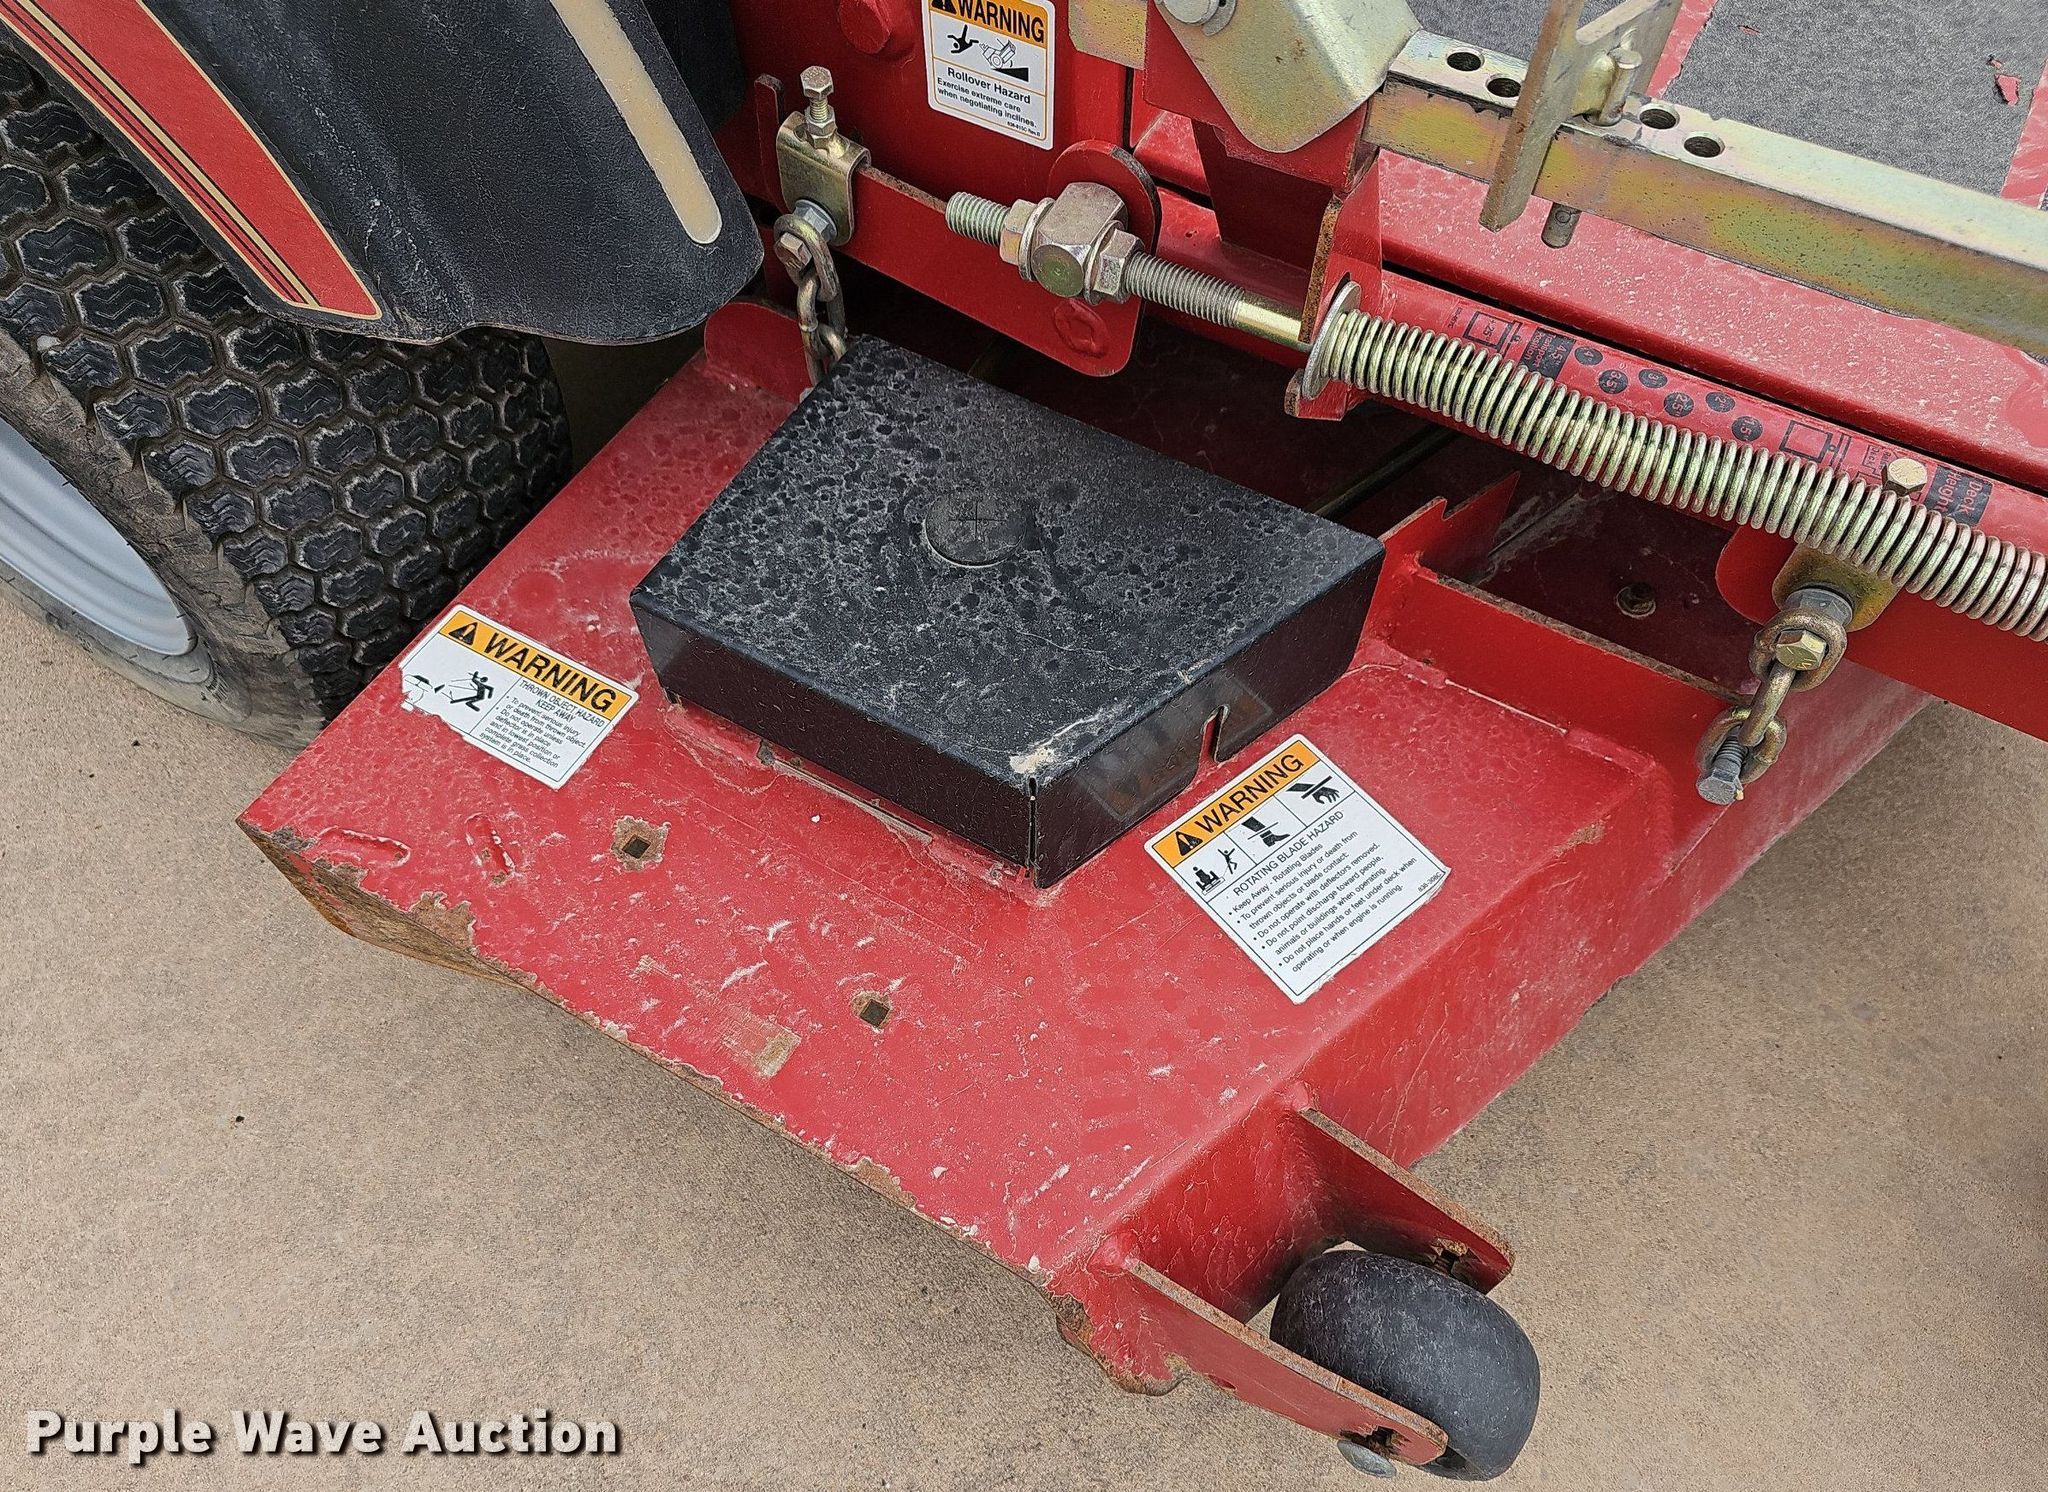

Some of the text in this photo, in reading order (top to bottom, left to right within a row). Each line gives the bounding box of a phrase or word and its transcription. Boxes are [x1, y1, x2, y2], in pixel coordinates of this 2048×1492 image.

[957, 0, 1045, 43] WARNING
[937, 77, 1021, 112] Exercise extreme care
[948, 67, 1030, 104] Rollover Hazard
[937, 88, 1036, 128] when negotiating inclines.
[1524, 331, 1546, 360] Position
[1535, 335, 1556, 368] Transport
[1936, 470, 1962, 512] Height
[1957, 479, 1985, 515] Deck
[484, 632, 616, 712] WARNING
[513, 708, 530, 718] death
[530, 716, 545, 726] from
[545, 724, 566, 737] thrown
[518, 702, 542, 716] prevent
[541, 714, 563, 727] serious
[563, 725, 581, 737] injury
[519, 680, 605, 727] THROWN OBJECT HAZARD
[535, 699, 575, 722] KEEP AWAY
[479, 732, 501, 745] system
[489, 721, 503, 729] and
[508, 730, 529, 743] lowest
[526, 741, 552, 756] position
[495, 715, 522, 731] deflector
[533, 736, 551, 747] place
[500, 708, 563, 744] Do not operate unless
[484, 727, 558, 768] complete grass collection
[1194, 755, 1304, 833] WARNING
[1233, 811, 1343, 896] ROTATING BLADE HAZARD
[1250, 893, 1276, 915] prevent
[1275, 876, 1299, 895] serious
[1297, 862, 1317, 877] injury
[1324, 842, 1343, 857] death
[1341, 831, 1358, 844] from
[1232, 898, 1251, 912] Keep
[1251, 884, 1269, 899] Away
[1272, 860, 1302, 882] Rotating
[1299, 843, 1323, 861] Blades
[1257, 842, 1380, 938] Do not operate with deflectors removed.
[1249, 911, 1273, 929] thrown
[1273, 893, 1297, 912] objects
[1303, 872, 1323, 887] blade
[1265, 937, 1277, 946] Do
[1277, 927, 1289, 938] not
[1288, 913, 1306, 930] point
[1306, 890, 1337, 915] discharge
[1336, 872, 1360, 891] toward
[1275, 868, 1386, 955] animals or buildings when operating.
[1282, 954, 1294, 963] Do
[1294, 944, 1306, 955] not
[1305, 931, 1324, 947] place
[1322, 914, 1344, 932] hands
[1351, 897, 1366, 909] feet
[1364, 883, 1383, 899] under
[1383, 871, 1400, 884] deck
[1399, 857, 1416, 872] when
[1292, 946, 1324, 972] operating
[1330, 926, 1349, 941] when
[1348, 909, 1370, 927] engine
[1376, 884, 1403, 905] running.
